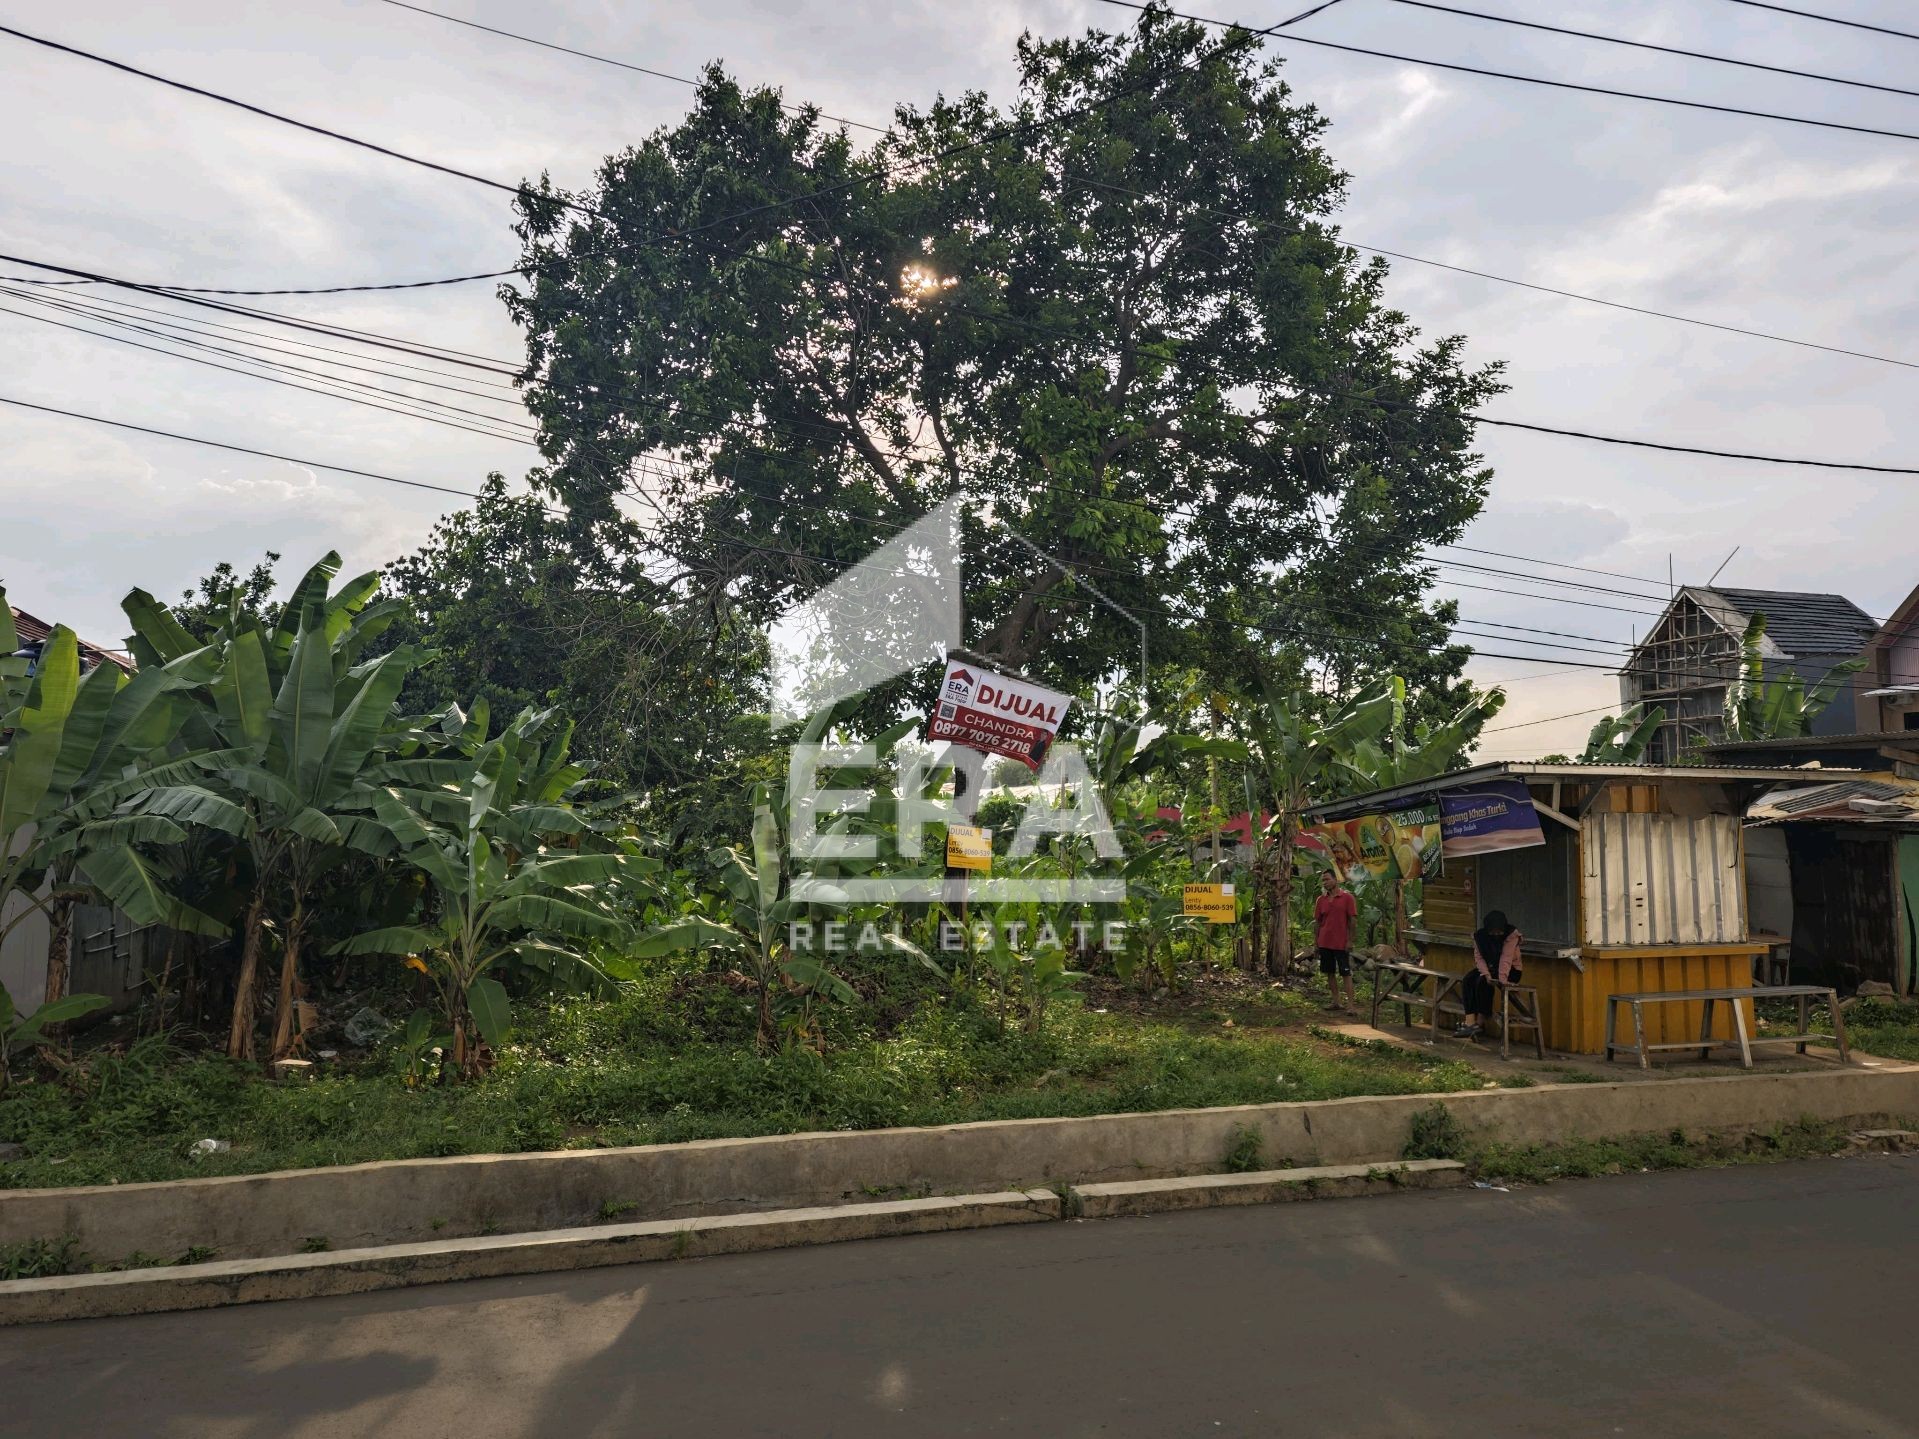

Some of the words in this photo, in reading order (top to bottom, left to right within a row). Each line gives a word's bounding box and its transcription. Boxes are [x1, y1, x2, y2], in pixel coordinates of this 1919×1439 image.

[948, 681, 969, 694] ERA
[976, 684, 1058, 725] DIJUAL
[964, 714, 1035, 740] CHANDRA
[934, 720, 967, 737] 0877
[969, 729, 1001, 746] 7076
[1002, 737, 1032, 754] 2718
[1396, 810, 1425, 827] 25.000
[1469, 808, 1487, 820] Khas
[950, 828, 973, 836] DIJUAL
[1185, 886, 1213, 894] DIJUAL
